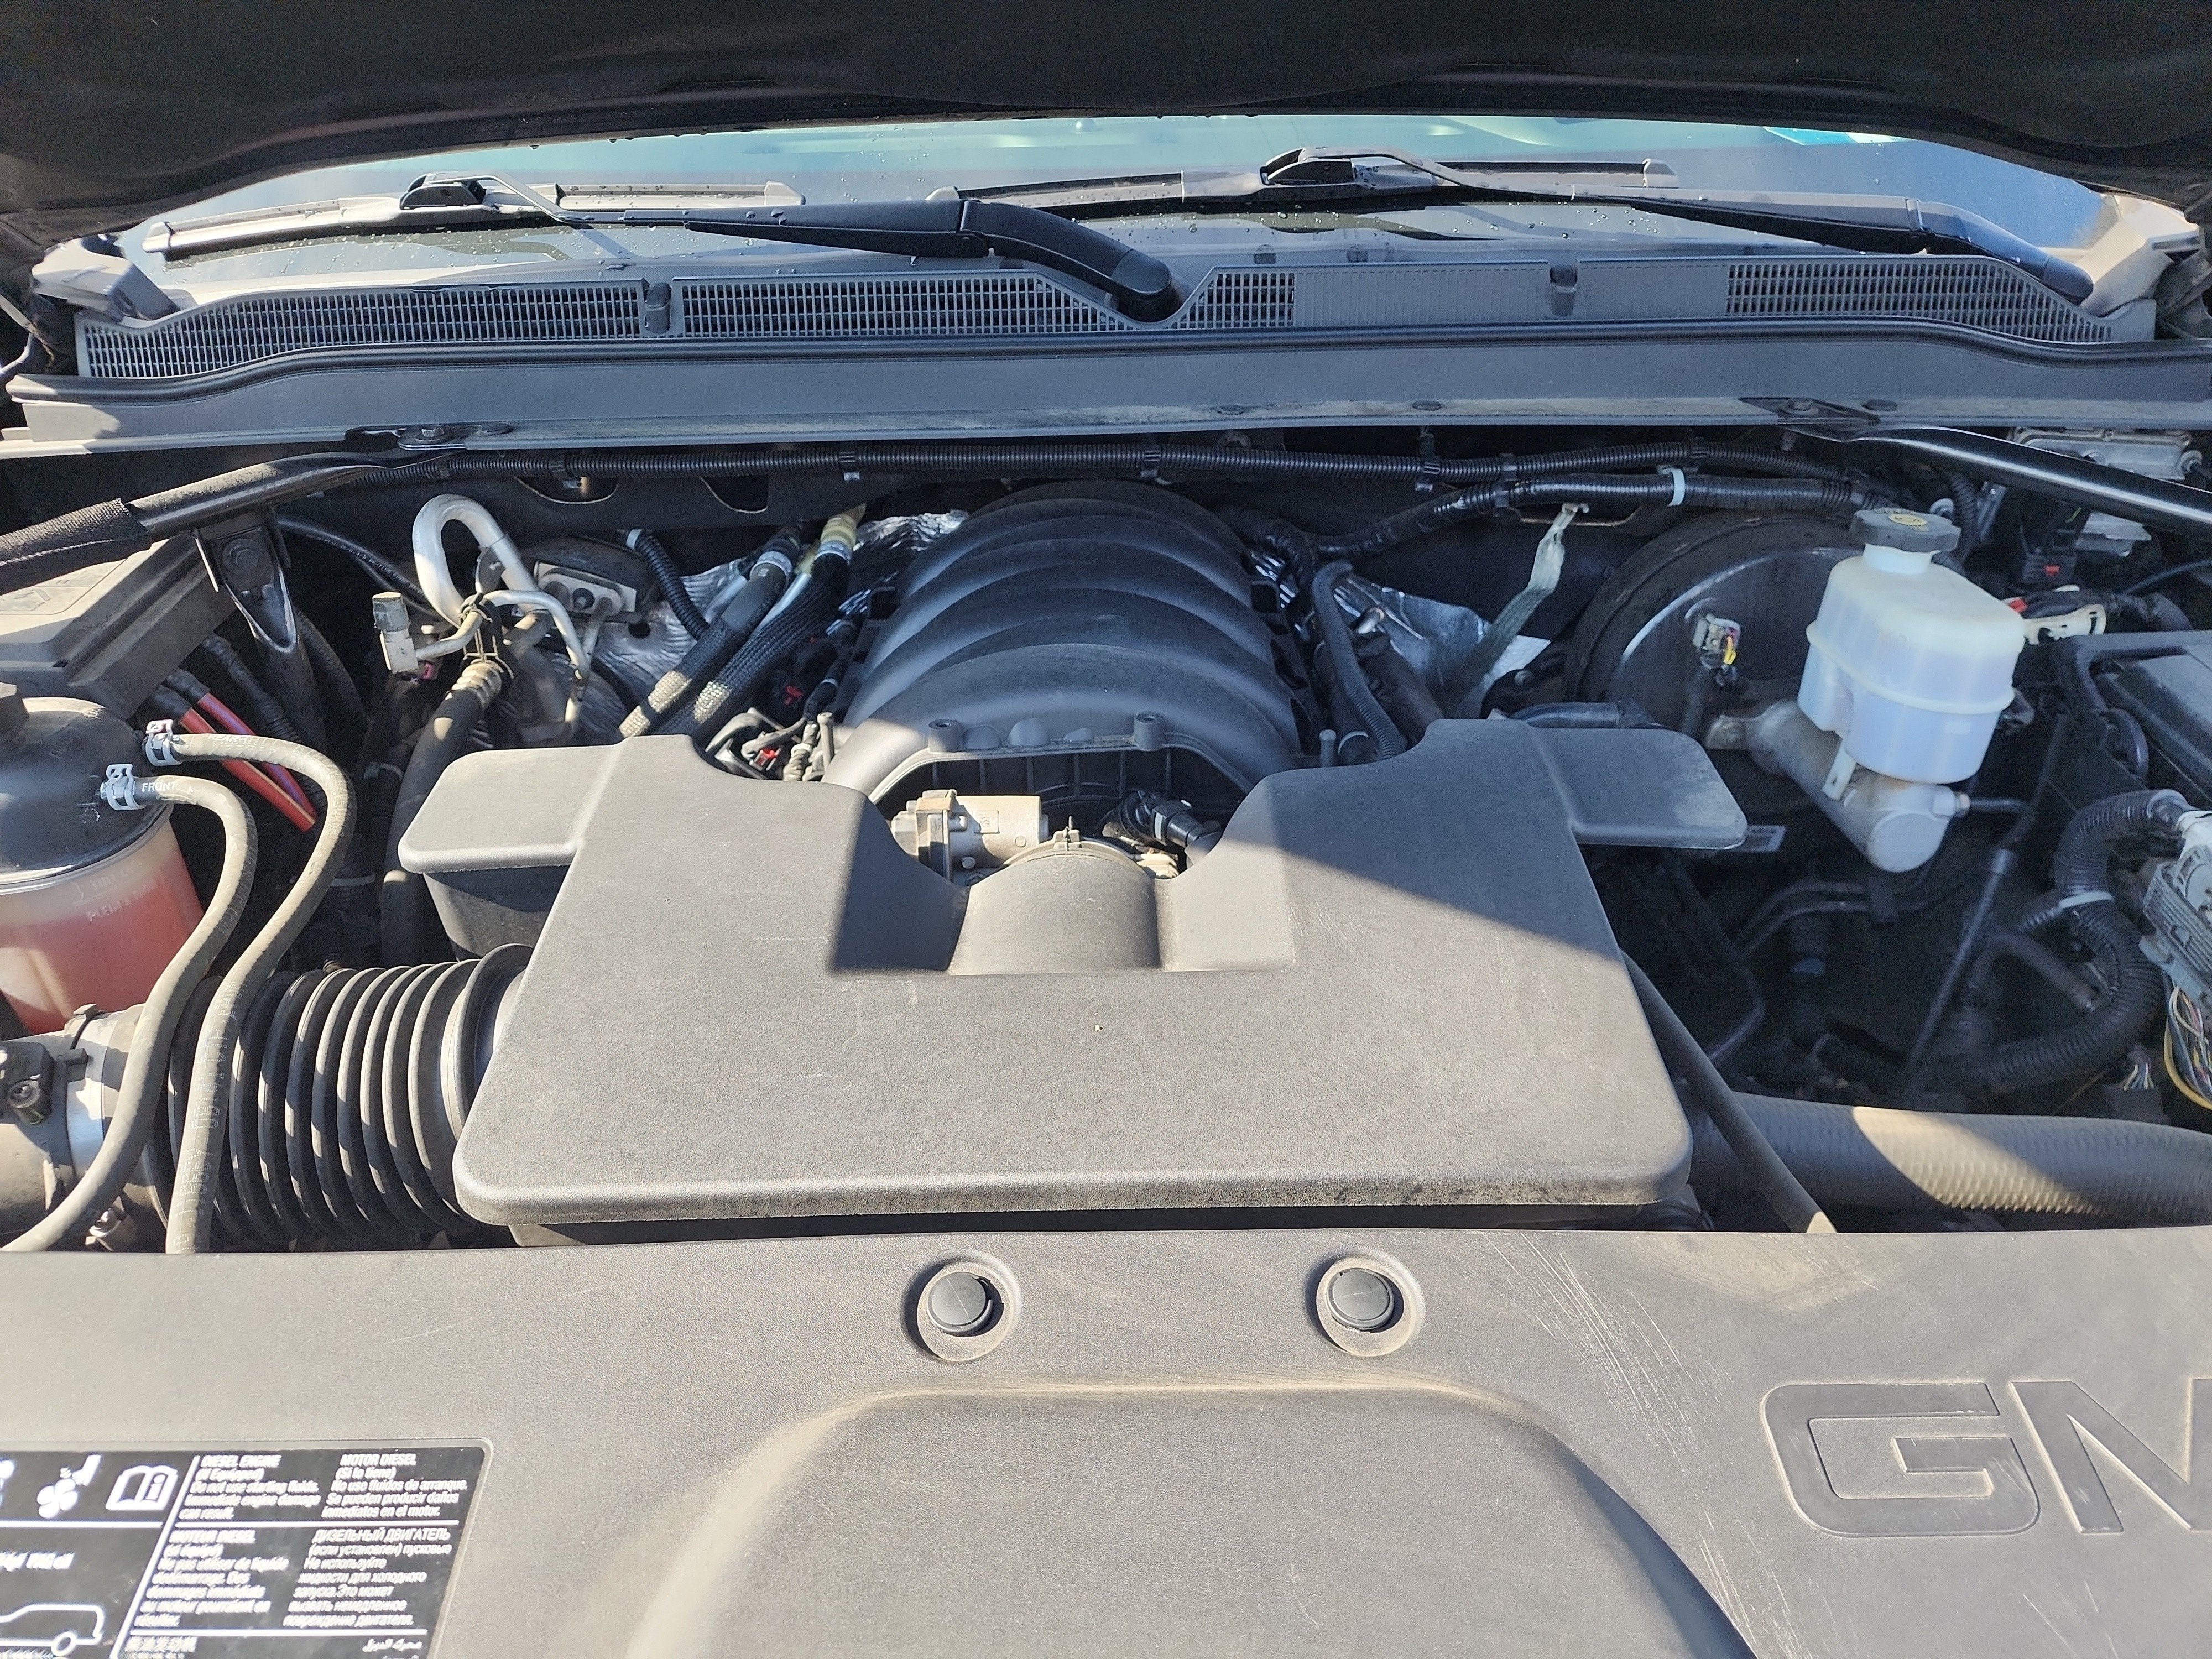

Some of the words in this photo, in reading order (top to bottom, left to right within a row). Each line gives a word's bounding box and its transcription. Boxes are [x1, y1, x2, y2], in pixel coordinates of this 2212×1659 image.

[142, 781, 176, 792] FRONT
[200, 1455, 238, 1468] DIESEL
[239, 1455, 281, 1468] ENGINE
[340, 1454, 380, 1466] MOTOR
[379, 1453, 416, 1465] DIESEL
[336, 1467, 353, 1480] (Si
[352, 1467, 364, 1479] lo
[364, 1467, 397, 1480] tiene)
[190, 1481, 207, 1493] Do
[225, 1483, 247, 1493] use
[246, 1480, 287, 1494] starting
[331, 1480, 347, 1493] No
[347, 1481, 368, 1493] use
[368, 1479, 404, 1491] fluidos
[404, 1479, 419, 1491] de
[419, 1480, 467, 1492] arranque.
[326, 1493, 342, 1505] Se
[341, 1493, 382, 1506] pueden
[381, 1492, 427, 1506] producir
[426, 1491, 459, 1504] daños
[321, 1506, 380, 1518] inmediatos
[380, 1507, 395, 1517] en
[395, 1505, 408, 1517] el
[407, 1505, 440, 1517] motor.
[312, 1527, 386, 1543] ДИЗЕЛЬНЫЙ
[384, 1528, 451, 1542] ДВИГАТЕЛЬ
[403, 1545, 452, 1557] пусковые
[303, 1557, 321, 1569] Не
[347, 1573, 371, 1584] для
[371, 1572, 427, 1584] холодного
